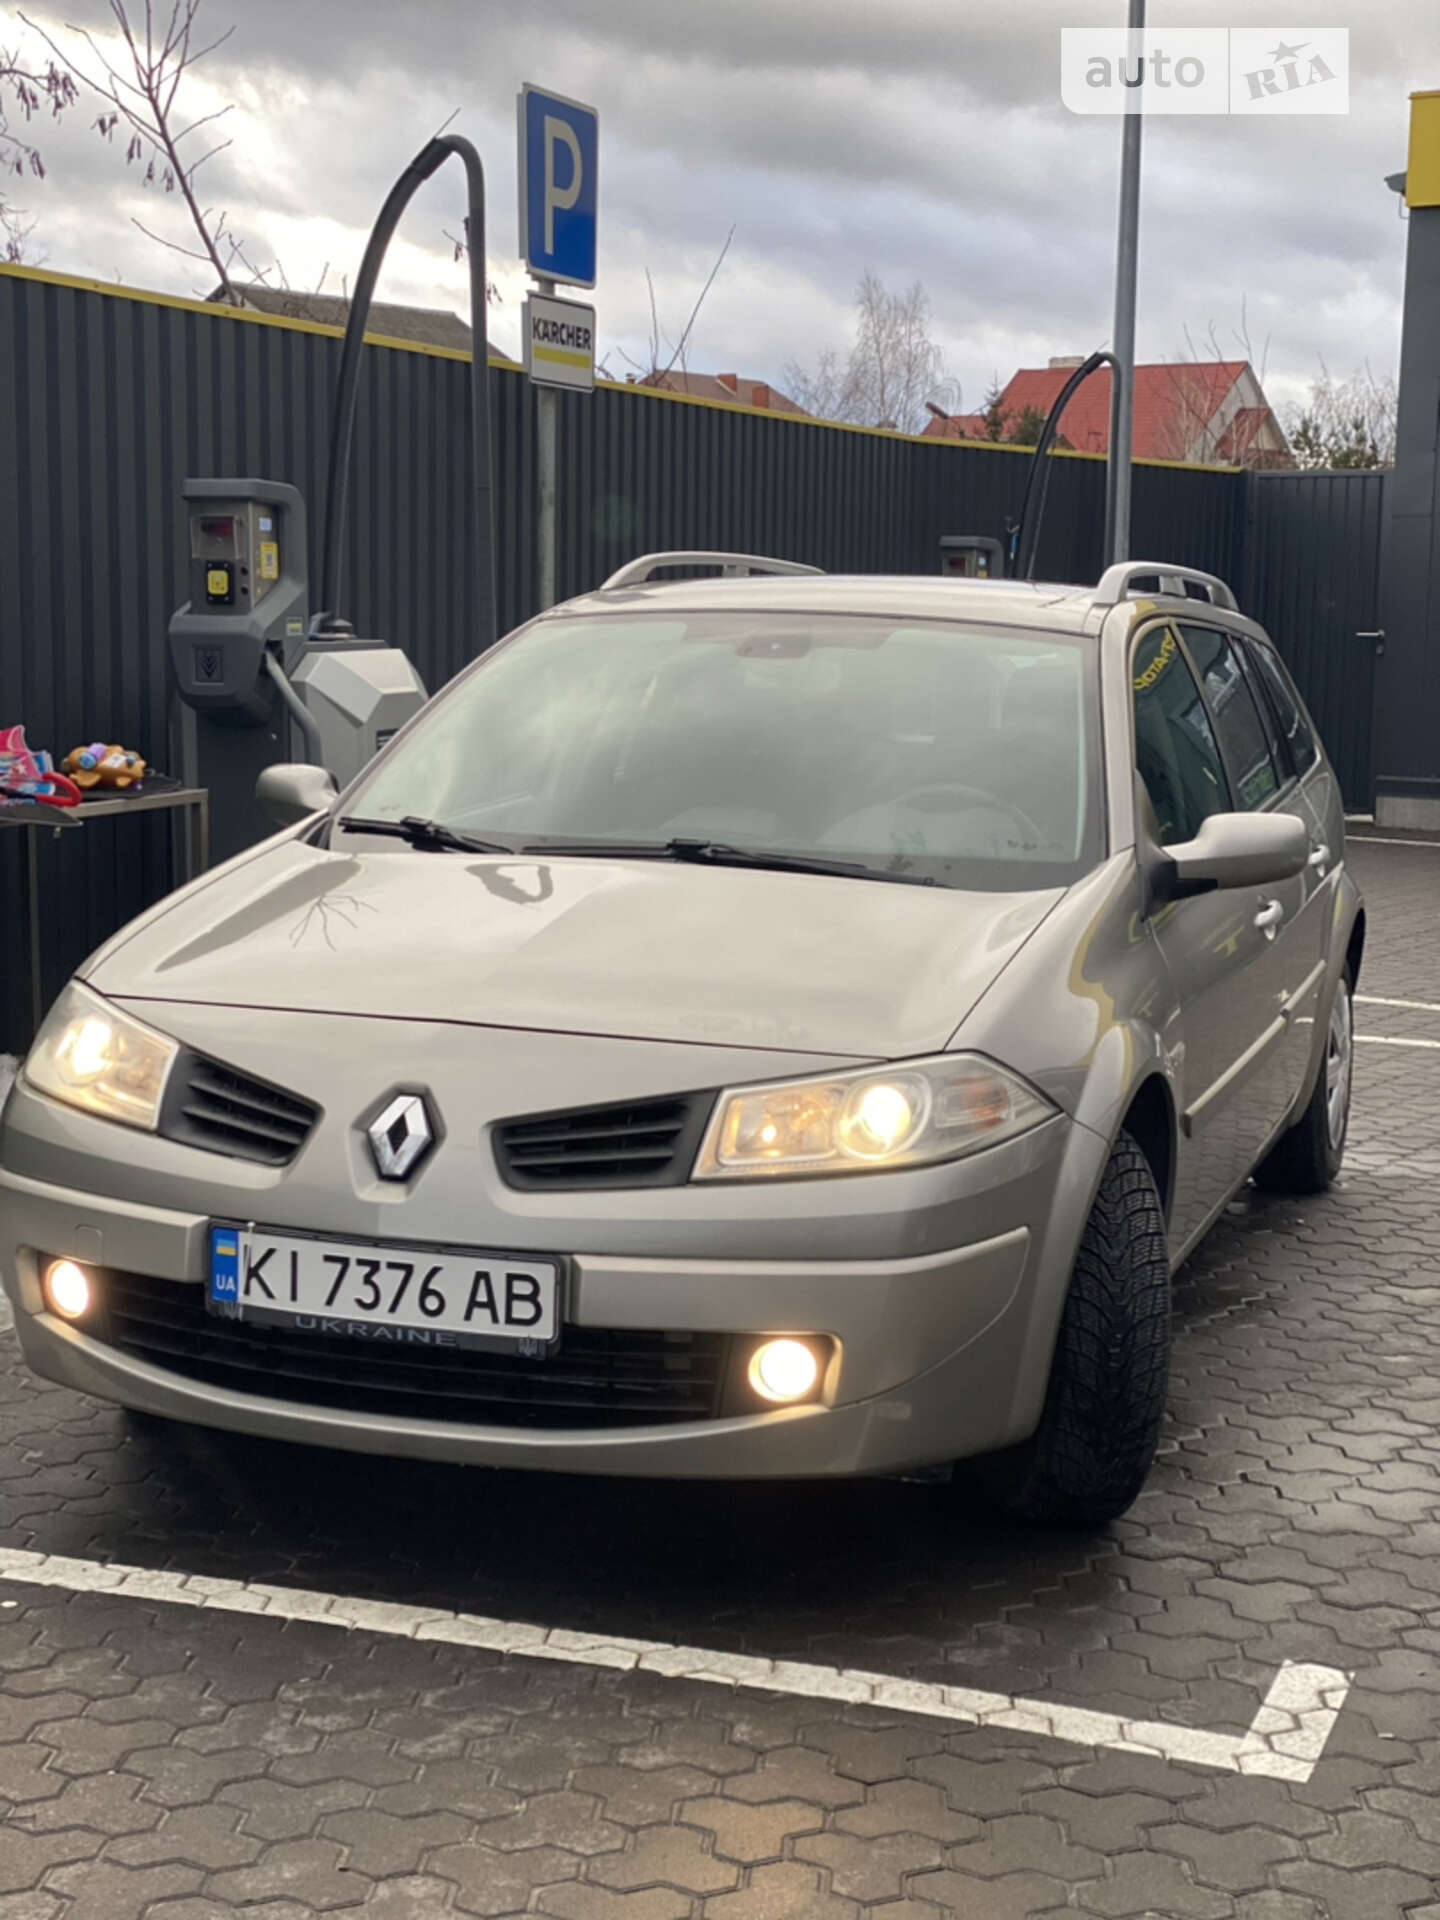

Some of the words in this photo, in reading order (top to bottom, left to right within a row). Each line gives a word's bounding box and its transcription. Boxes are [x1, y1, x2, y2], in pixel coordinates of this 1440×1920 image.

[544, 115, 583, 256] P
[216, 1274, 237, 1292] UA
[243, 1244, 298, 1302] KI
[322, 1254, 446, 1318] 7376
[463, 1270, 543, 1327] AB
[294, 1315, 457, 1347] UKRAINE
